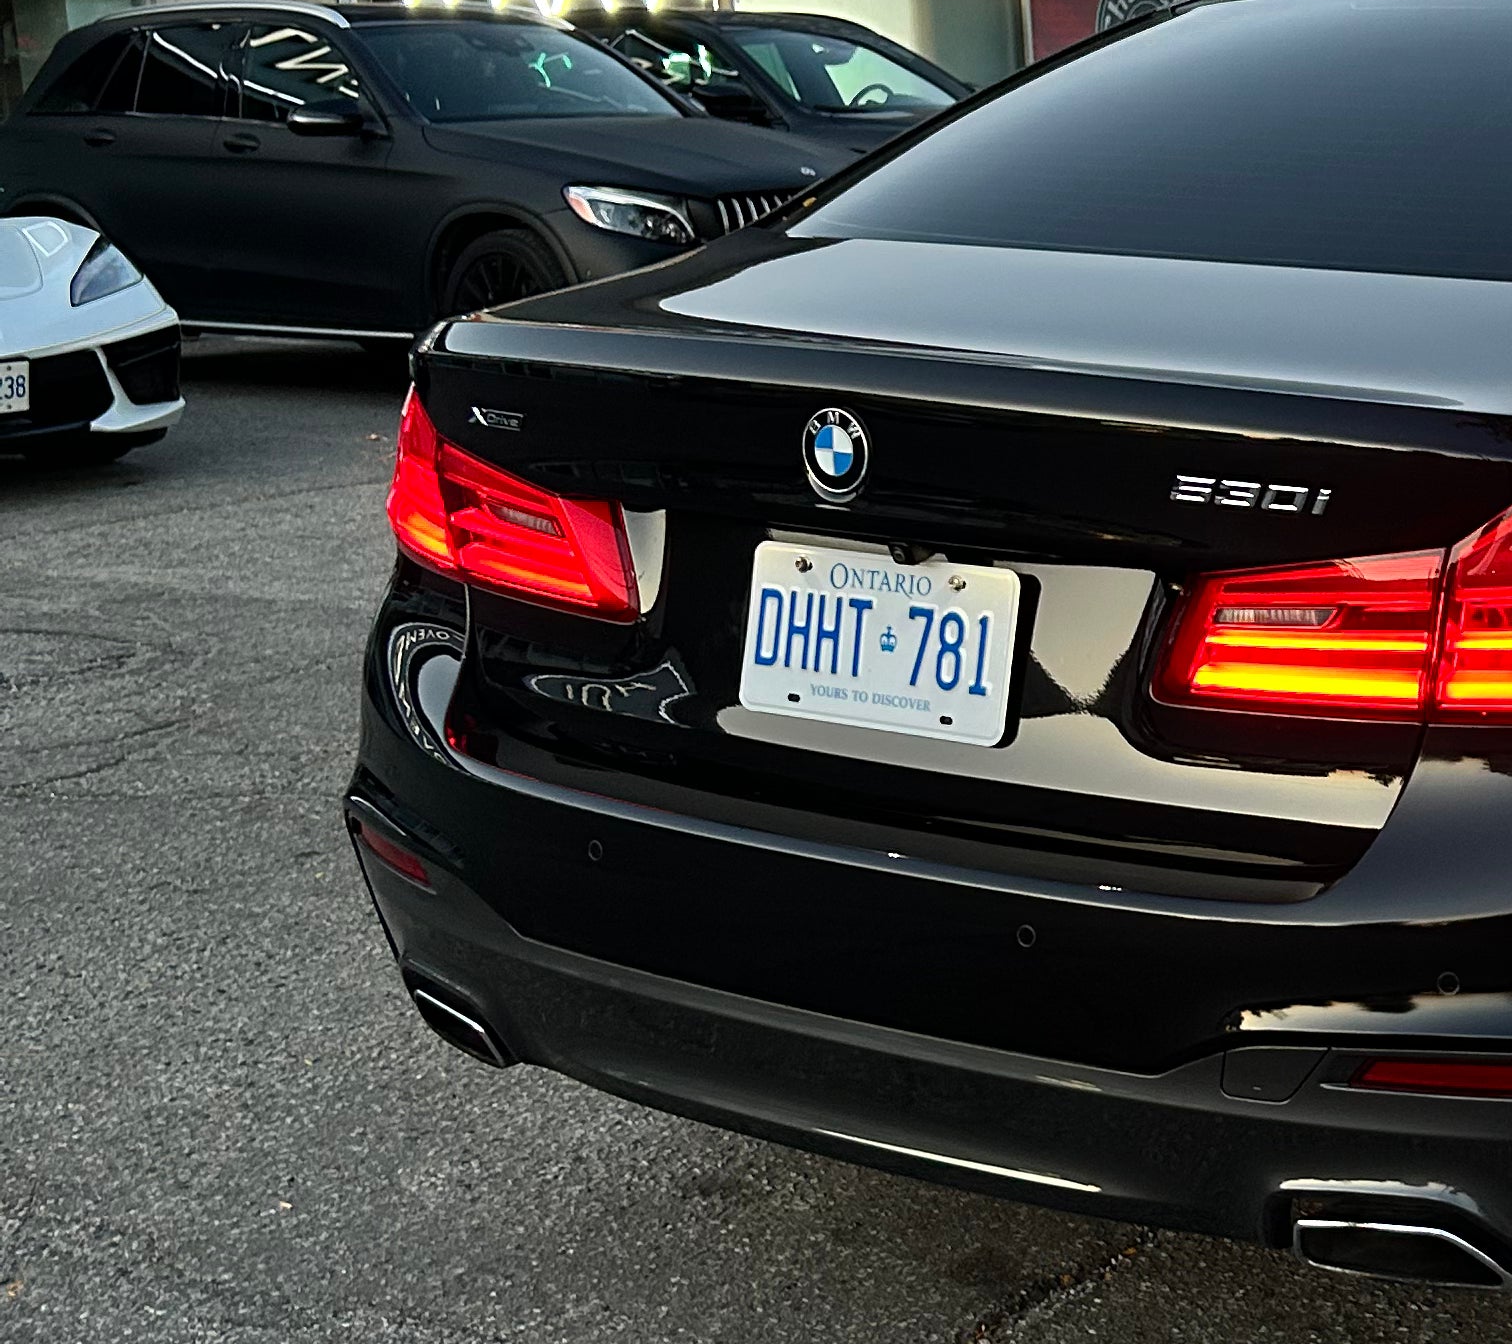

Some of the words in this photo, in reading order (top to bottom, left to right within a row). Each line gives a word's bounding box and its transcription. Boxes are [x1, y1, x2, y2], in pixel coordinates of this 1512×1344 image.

[809, 411, 862, 439] BMW
[1169, 475, 1332, 515] 530i
[830, 562, 932, 599] ONTARIO
[754, 587, 873, 677] DHHT
[908, 606, 990, 696] 781
[809, 683, 848, 701] YOURS
[852, 688, 869, 703] TO
[871, 691, 931, 712] DISCOVER
